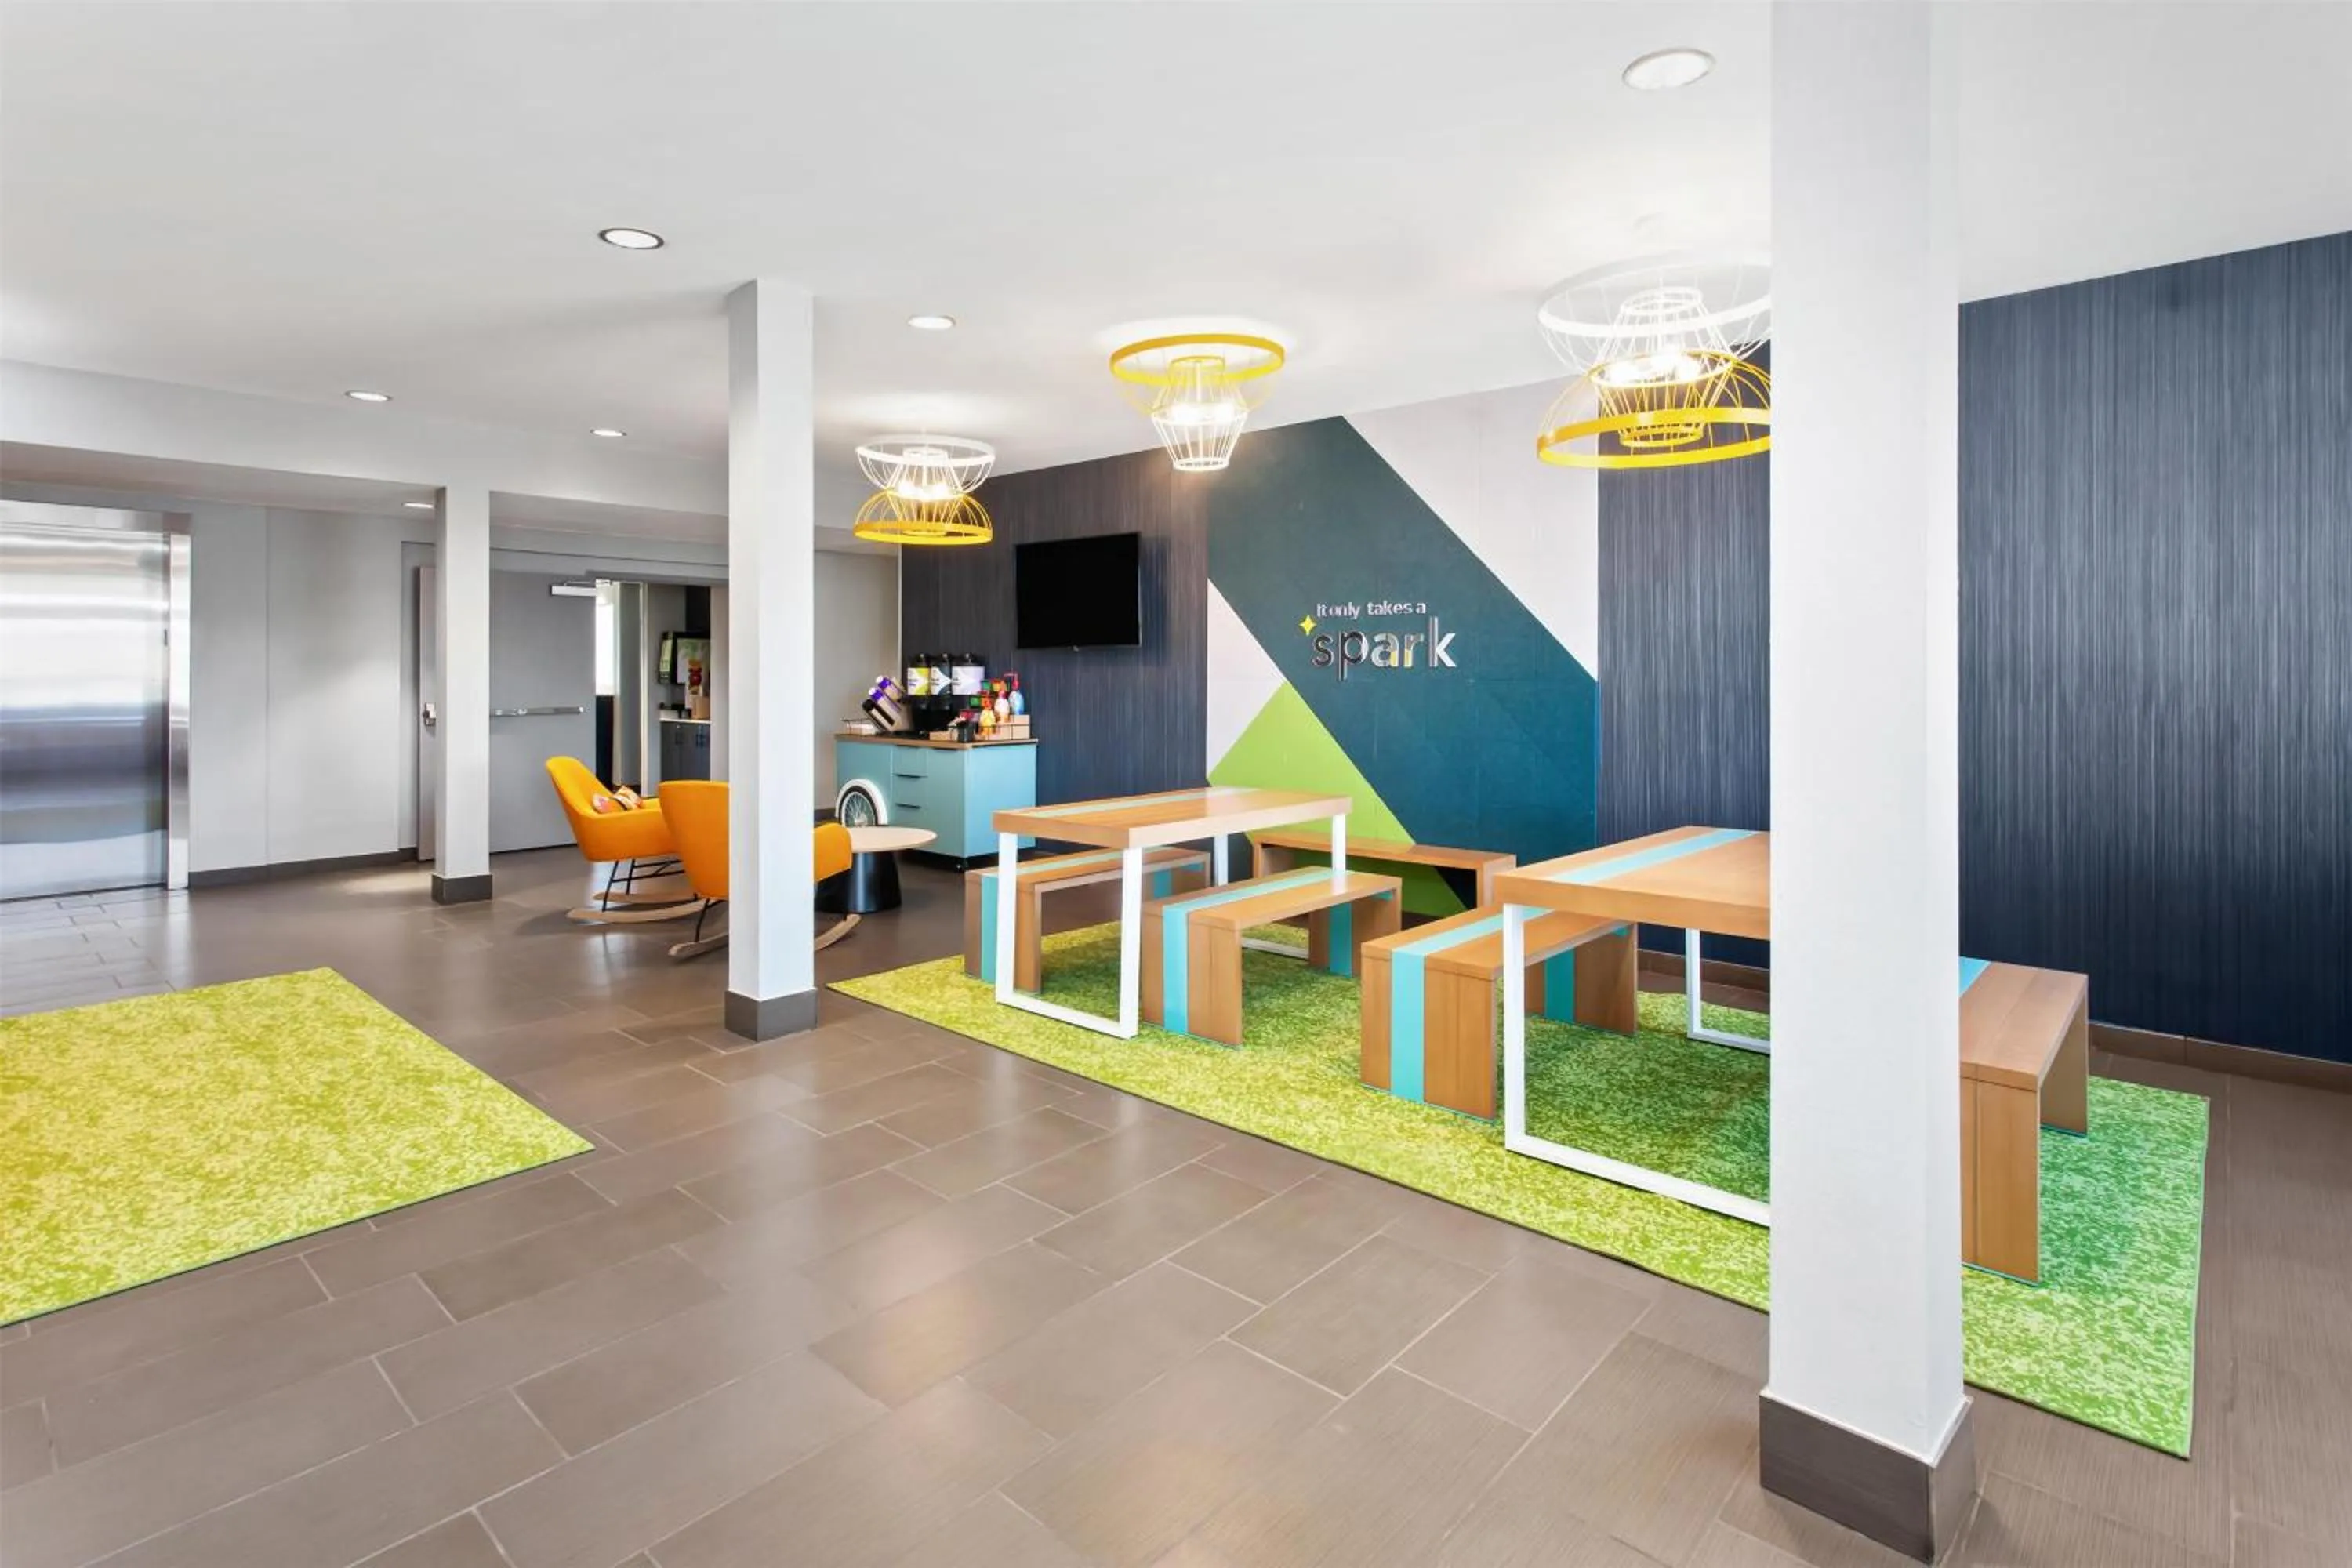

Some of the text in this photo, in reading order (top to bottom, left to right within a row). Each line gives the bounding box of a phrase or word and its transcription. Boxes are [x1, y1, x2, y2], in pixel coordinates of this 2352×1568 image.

[1317, 600, 1426, 619] It only takes a
[1312, 616, 1457, 681] spark
